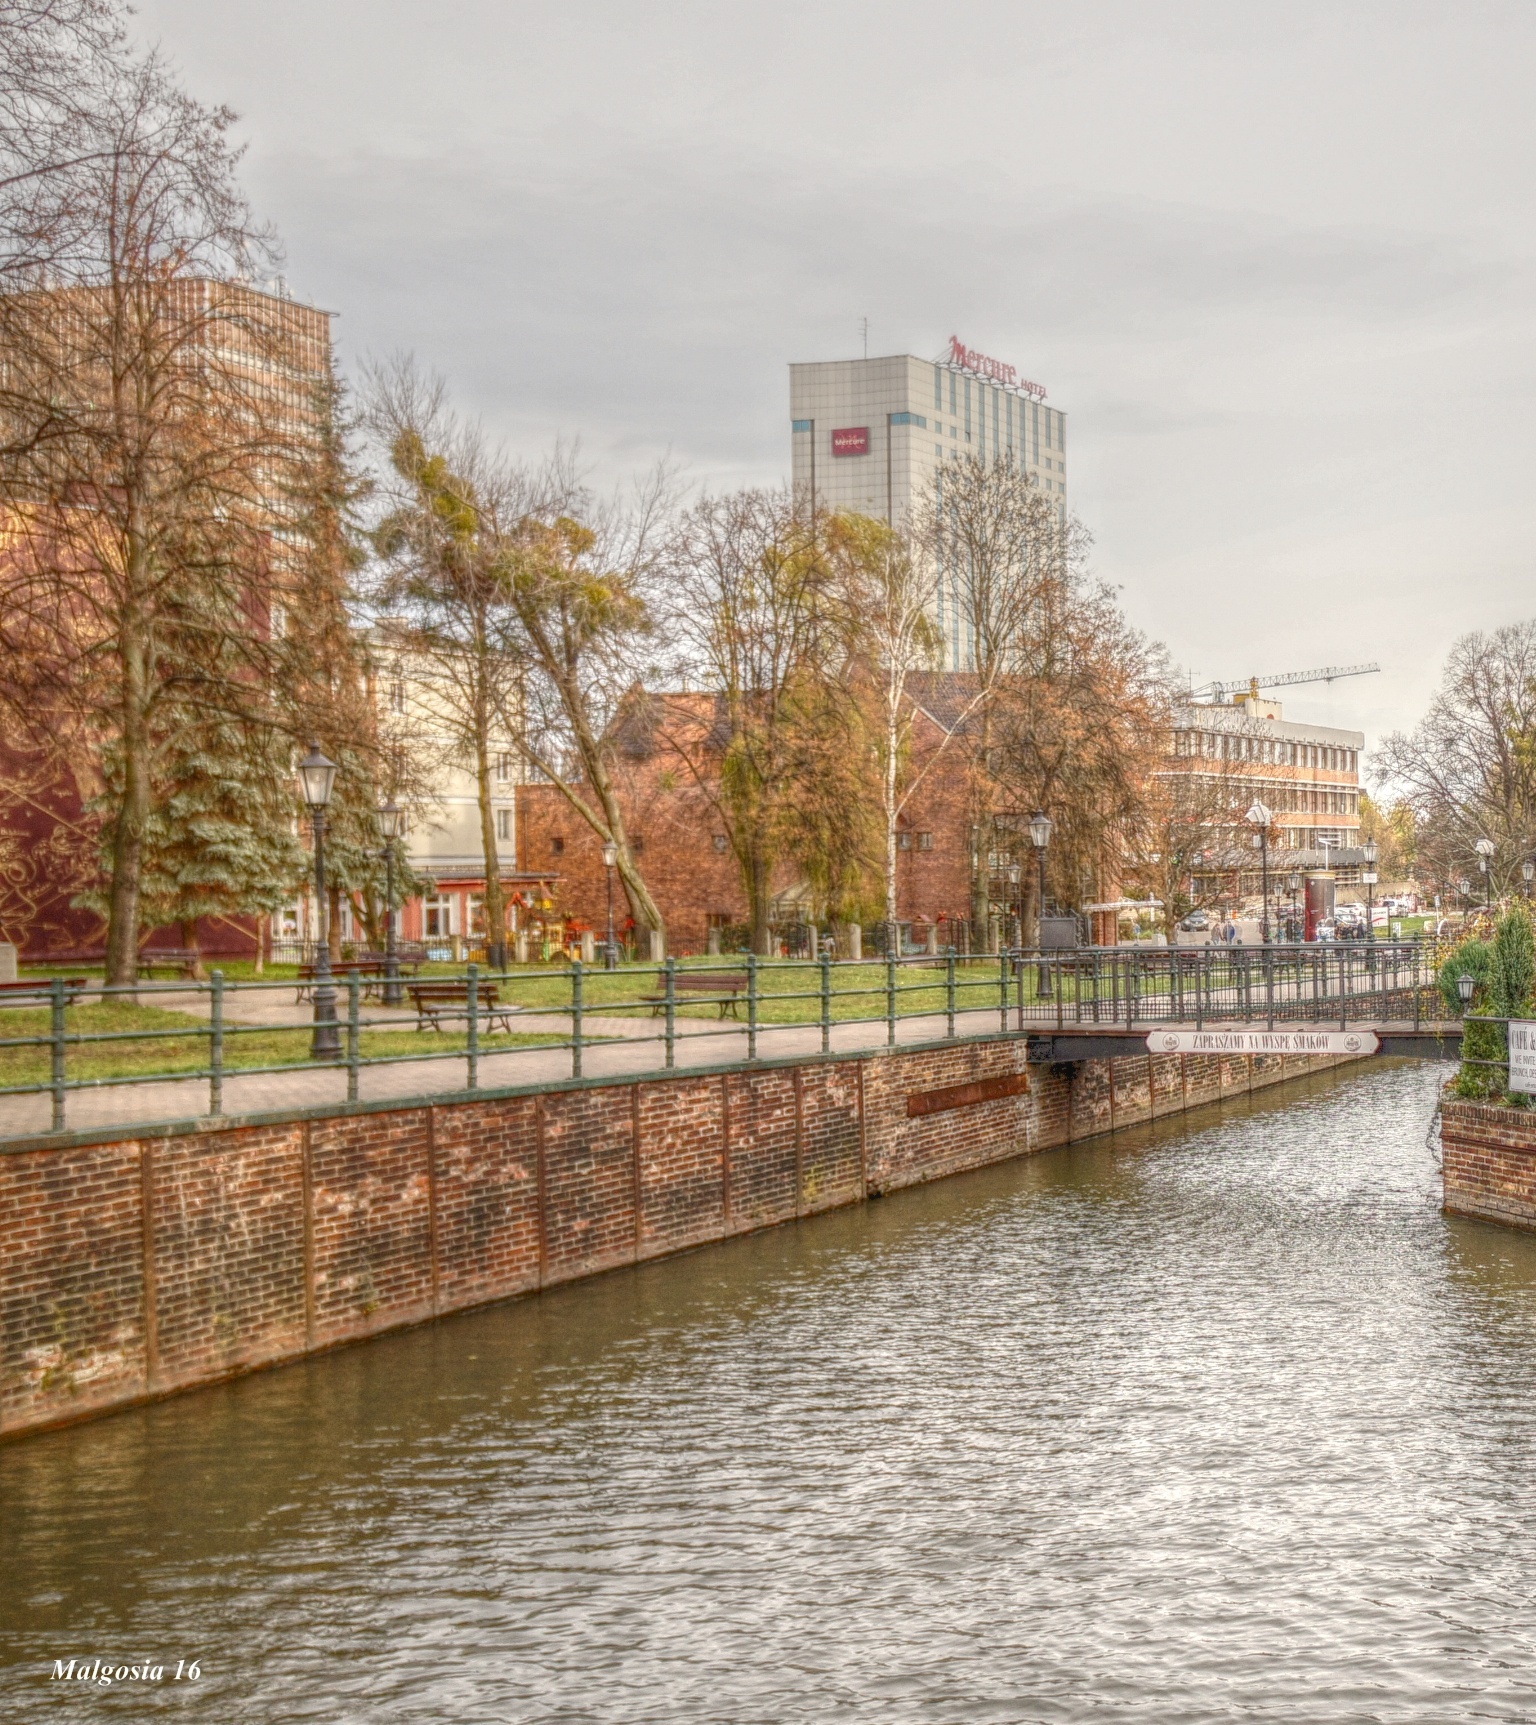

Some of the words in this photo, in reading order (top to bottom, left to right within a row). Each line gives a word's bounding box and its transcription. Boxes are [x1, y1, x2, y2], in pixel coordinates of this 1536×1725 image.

[949, 335, 1016, 385] Mercure
[1020, 379, 1047, 398] HOTEL
[1193, 1034, 1246, 1049] ZAPRASZAMY
[1248, 1035, 1259, 1049] NA
[1262, 1035, 1291, 1051] WYSPĘ
[1511, 1026, 1528, 1051] CAFÉ
[1530, 1032, 1536, 1051] &
[1515, 1055, 1522, 1064] WE
[1523, 1055, 1536, 1066] INVITE
